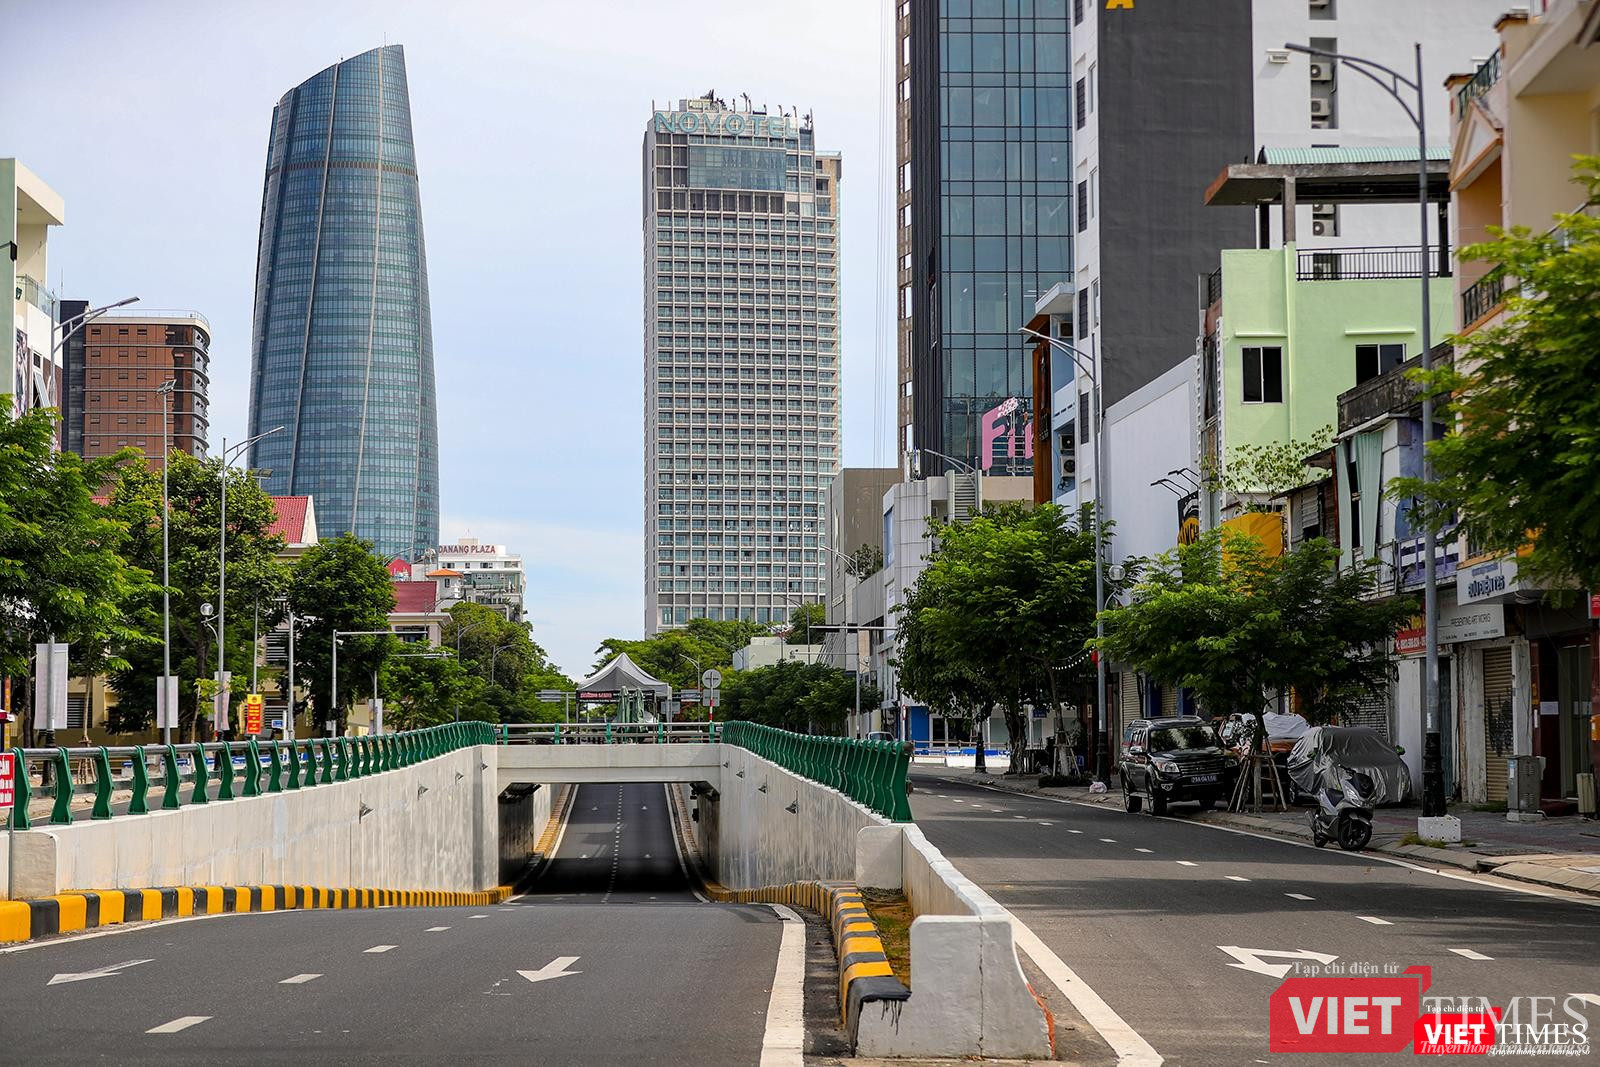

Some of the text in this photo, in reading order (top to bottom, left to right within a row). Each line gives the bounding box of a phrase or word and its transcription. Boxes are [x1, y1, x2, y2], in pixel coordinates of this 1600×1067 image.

[654, 111, 798, 138] NOVOTEL
[439, 545, 496, 554] DANANG PLAZA
